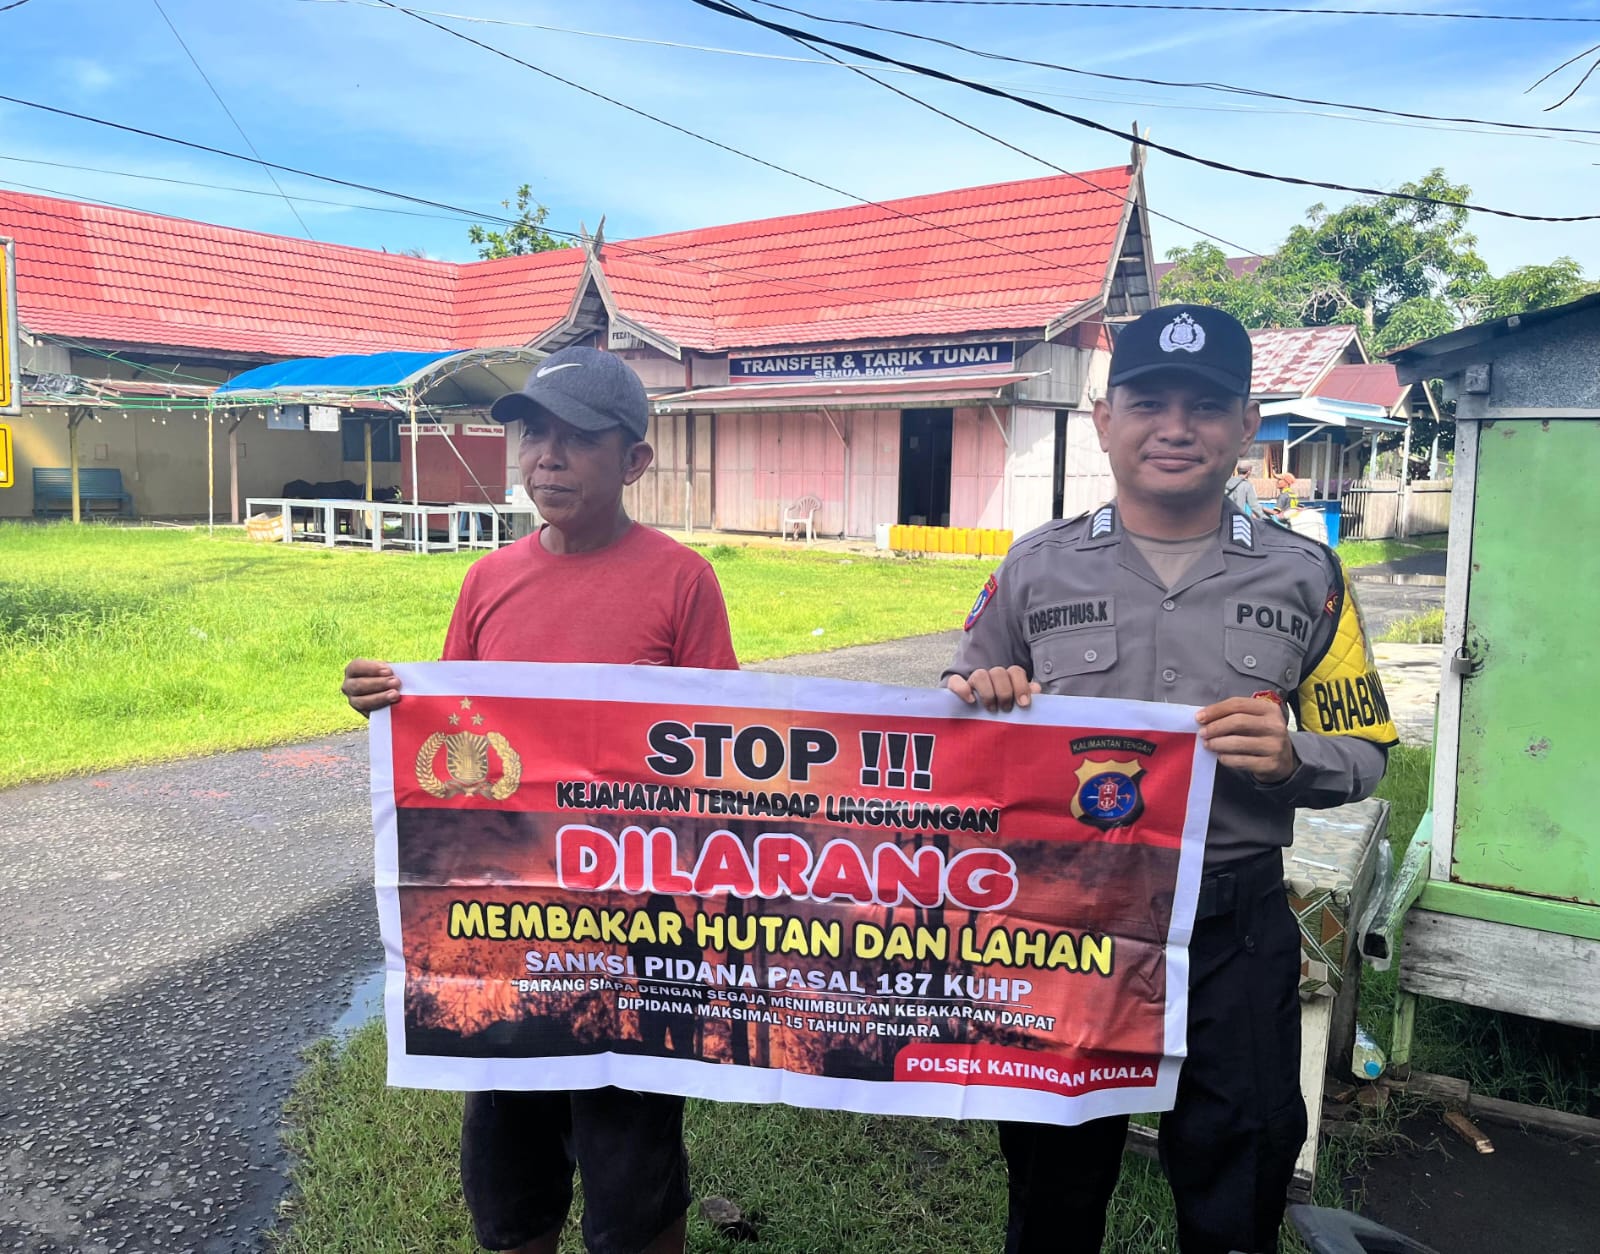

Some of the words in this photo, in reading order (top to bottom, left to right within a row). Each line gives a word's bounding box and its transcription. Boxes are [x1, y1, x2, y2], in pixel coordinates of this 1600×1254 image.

[741, 355, 835, 374] TRANSFER
[841, 353, 855, 368] &
[862, 350, 923, 368] TARIK
[930, 346, 998, 364] TUNAI
[814, 368, 861, 379] SEMUA
[865, 367, 906, 377] BANK
[1028, 600, 1108, 636] ROBERTHUS.K
[1236, 603, 1310, 643] POLRI
[646, 720, 837, 784] STOP
[859, 730, 936, 792] !!!
[1072, 739, 1120, 752] KALIMANTAN
[1123, 740, 1153, 753] TENGAH
[556, 781, 691, 813] KEJAHATAN
[694, 787, 820, 820] TERHADAP
[825, 795, 1000, 834] LINGKUNGAN
[556, 824, 1019, 911] DILARANG
[448, 901, 682, 947] MEMBAKAR
[696, 911, 842, 959] HUTAN
[854, 924, 946, 964] DAN
[961, 928, 1115, 977] LAHAN
[525, 951, 634, 975] SANKSI
[645, 956, 757, 988] PIDANA
[767, 966, 866, 994] PASAL
[876, 972, 933, 996] 187
[944, 974, 1033, 1002] KUHP
[589, 979, 634, 992] SIAPA
[638, 984, 702, 999] DENGAN
[706, 989, 765, 1006] SEGAJA
[771, 996, 890, 1017] MENIMBULKAN
[895, 1004, 996, 1023] KEBAKARAN
[1001, 1013, 1056, 1032] DAPAT
[618, 997, 693, 1015] DIPIDANA
[697, 1005, 781, 1025] MAKSIMAL
[786, 1014, 803, 1030] 15
[807, 1020, 864, 1034] TAHUN
[866, 1022, 941, 1038] PENJARA
[906, 1057, 981, 1074] POLSEK
[987, 1060, 1085, 1087] KATINGAN
[1090, 1066, 1154, 1082] KUALA
